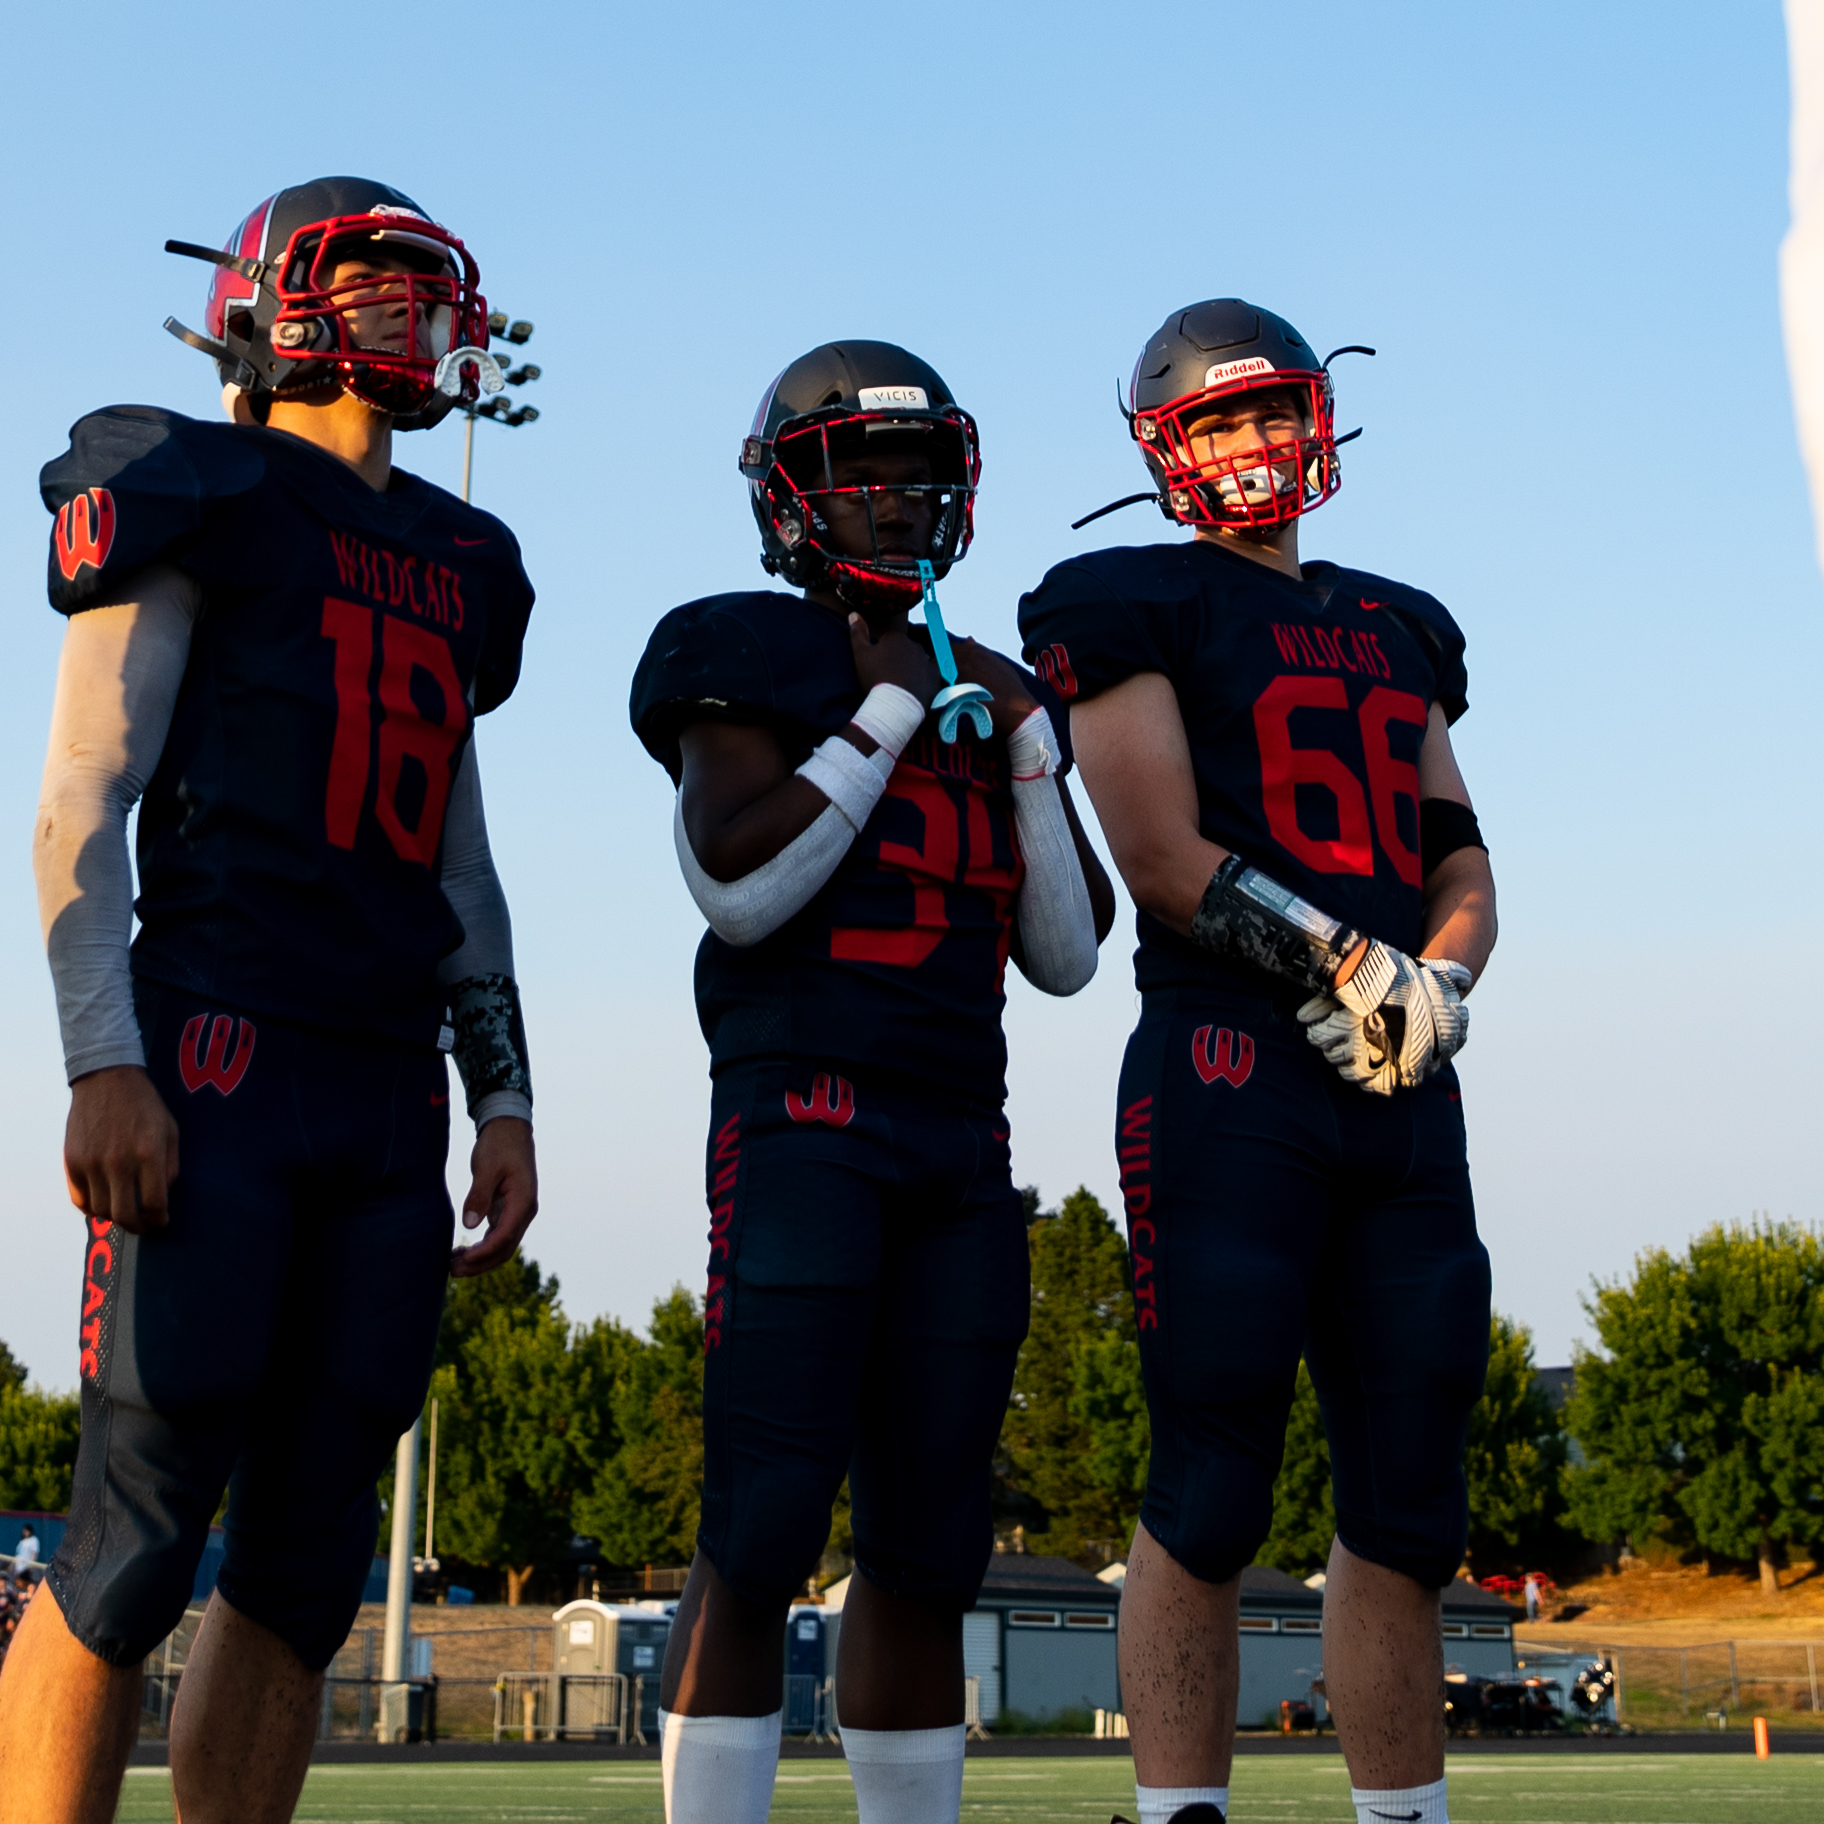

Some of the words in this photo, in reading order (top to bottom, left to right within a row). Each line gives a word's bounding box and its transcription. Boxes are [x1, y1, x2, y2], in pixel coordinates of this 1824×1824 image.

[873, 390, 917, 402] VICIS
[1213, 359, 1266, 380] Riddell
[55, 486, 117, 581] W
[329, 529, 466, 633] WILDCATS
[1268, 621, 1392, 681] WILDCATS
[319, 595, 469, 872] 18
[1252, 674, 1427, 890] 66
[178, 1012, 257, 1097] W
[1192, 1023, 1256, 1089] W
[704, 1110, 743, 1352] WILDCATS
[1120, 1093, 1159, 1332] WILDCATS
[80, 1215, 114, 1379] DCATS
